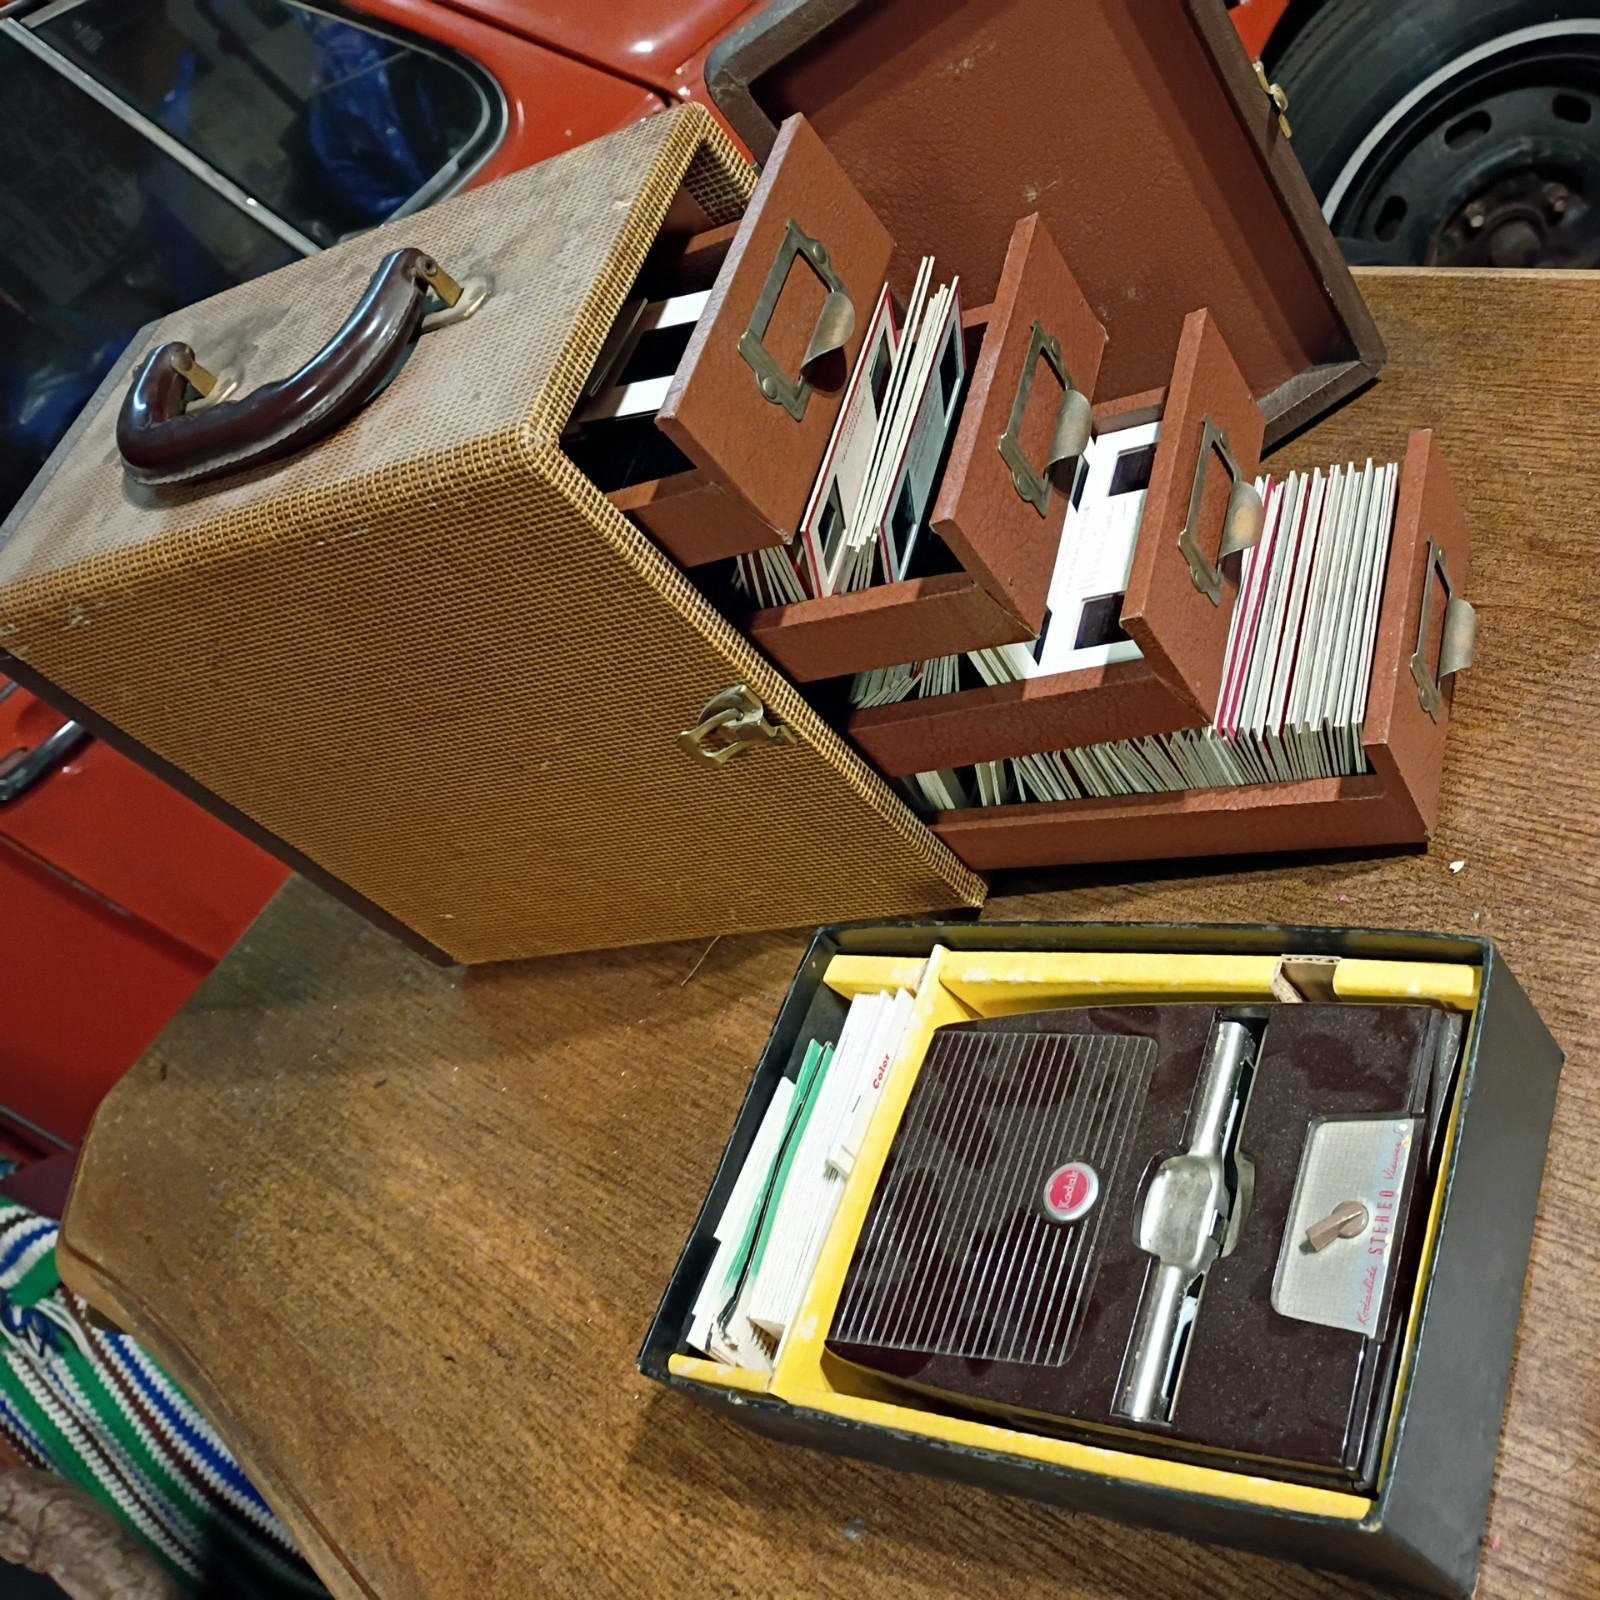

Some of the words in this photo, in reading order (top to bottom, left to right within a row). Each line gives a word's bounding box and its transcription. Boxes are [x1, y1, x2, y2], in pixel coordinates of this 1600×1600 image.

[873, 1053, 889, 1089] Color
[1058, 1170, 1079, 1209] Kodak
[1357, 1265, 1377, 1325] Kodaslide
[1368, 1190, 1395, 1256] STEREO
[1382, 1142, 1402, 1180] Viewer
